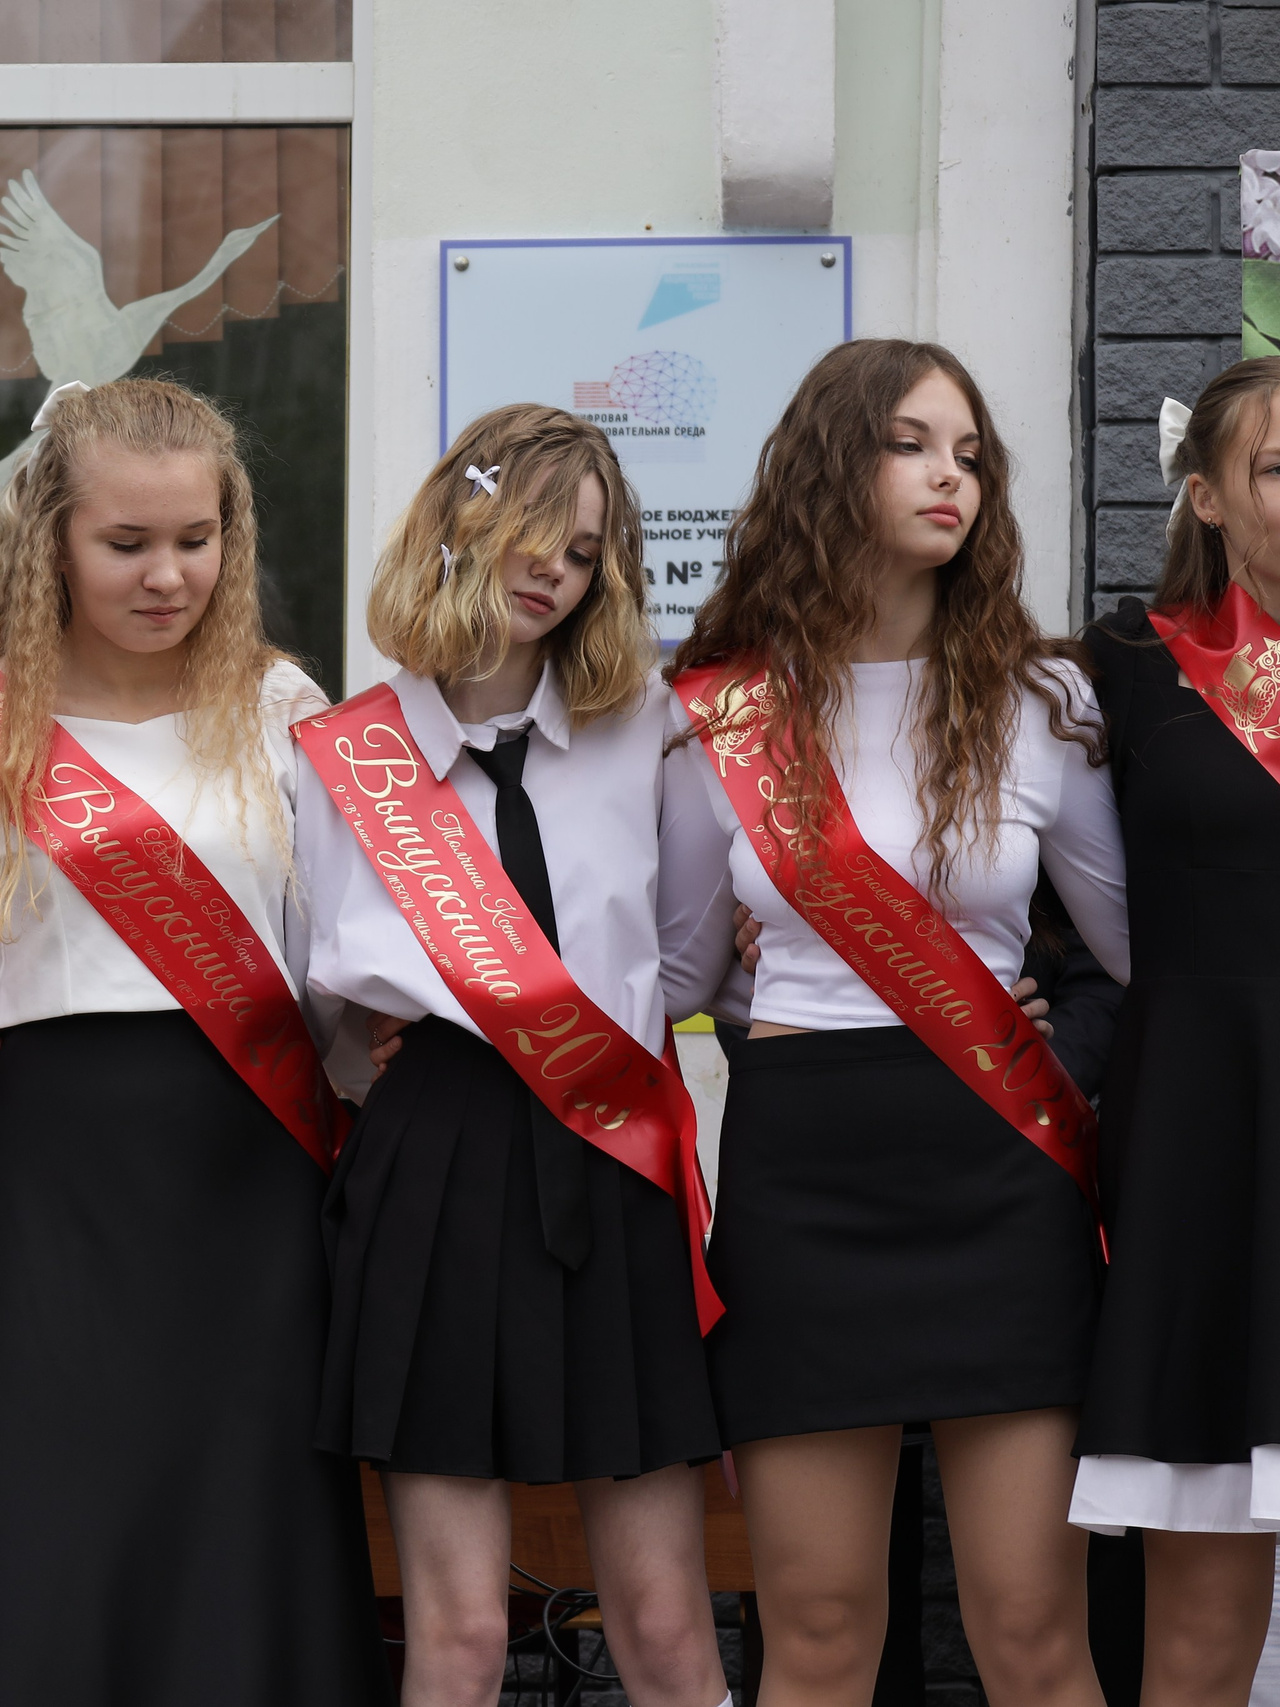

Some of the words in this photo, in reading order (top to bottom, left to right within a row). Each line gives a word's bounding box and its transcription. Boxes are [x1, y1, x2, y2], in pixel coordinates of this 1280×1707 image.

[574, 413, 628, 423] ИФРОВАЯ
[600, 426, 670, 437] ОВАТЕЛЬНАЯ
[674, 426, 706, 438] СРЕДА
[696, 528, 726, 541] УЧР
[331, 784, 346, 793] 9
[352, 819, 374, 850] класс
[382, 871, 415, 911] МБОУ
[334, 722, 521, 1007] Выпускница
[431, 809, 487, 890] Толчина
[479, 892, 528, 955] Ксения
[751, 824, 765, 834] 9
[810, 911, 846, 947] МБОУ
[31, 762, 255, 1023] Выпускница
[104, 903, 144, 940] МБОУ
[201, 897, 257, 974] Варвара
[915, 913, 959, 964] Олеся
